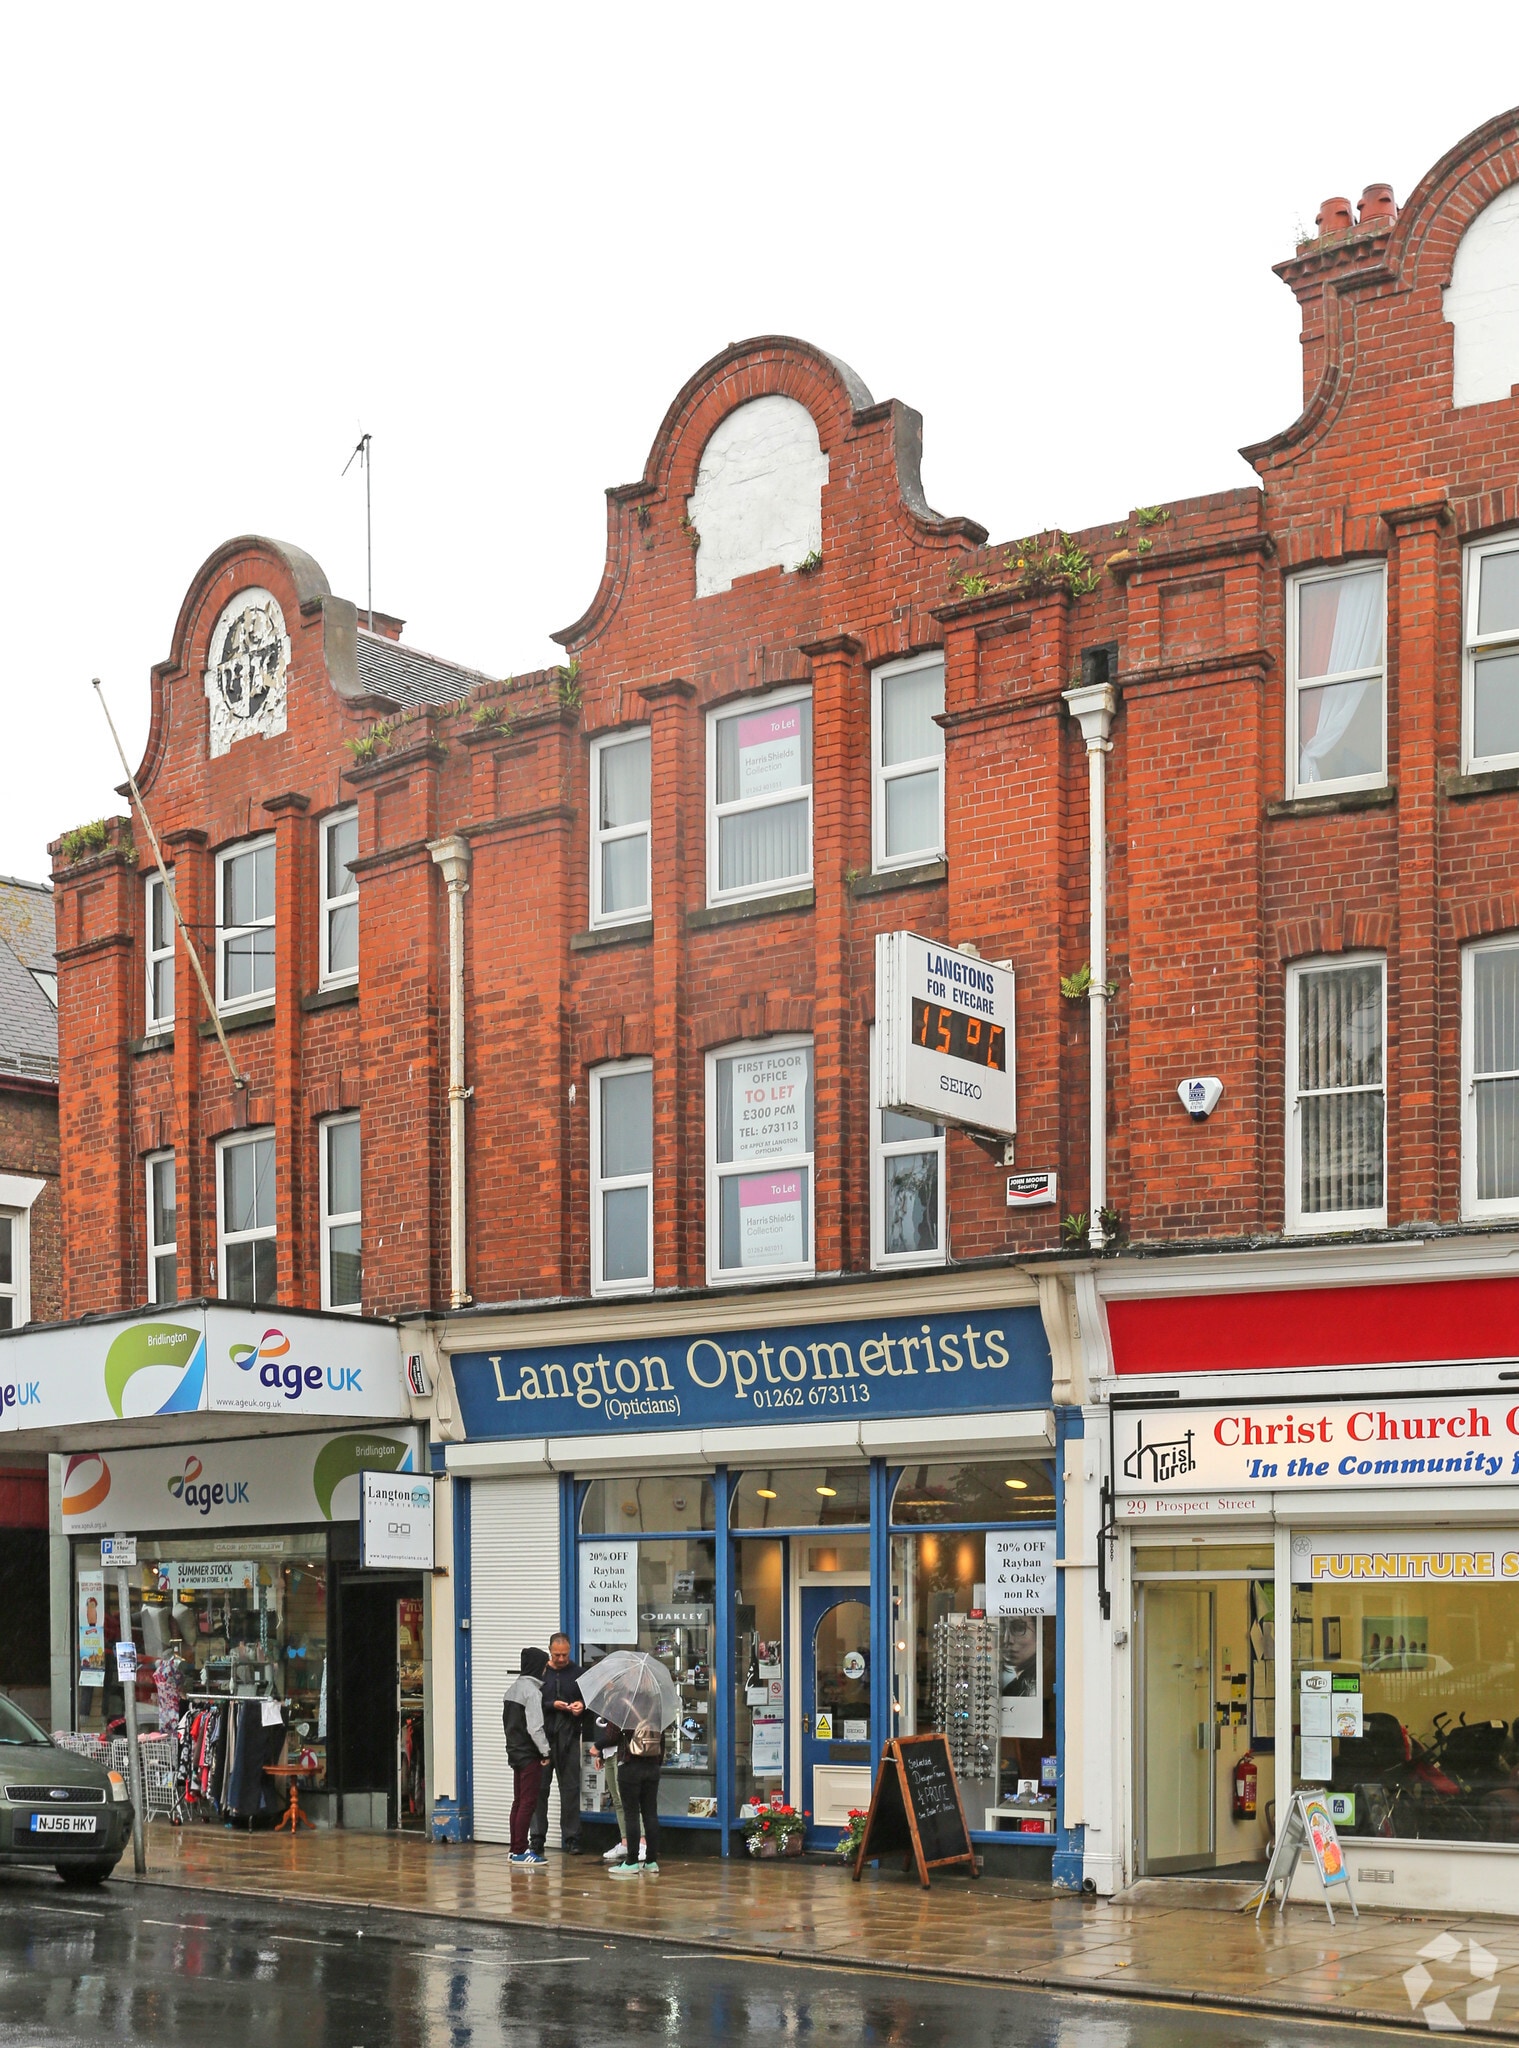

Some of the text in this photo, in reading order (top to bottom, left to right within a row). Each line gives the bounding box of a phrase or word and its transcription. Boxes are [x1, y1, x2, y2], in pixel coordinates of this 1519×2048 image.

[770, 719, 795, 732] To Let
[745, 749, 794, 767] Harris Shields
[745, 762, 782, 776] Collection
[927, 952, 994, 994] LANGTONS
[927, 979, 994, 1016] FOR EYECARE
[737, 1056, 802, 1073] FIRST FLOOR
[752, 1071, 788, 1084] OFFICE
[745, 1085, 795, 1103] TO LET
[940, 1075, 982, 1100] SEIKO
[743, 1104, 796, 1120] £300 PCM
[739, 1121, 799, 1138] TEL: 673113
[749, 1141, 764, 1149] APPLY
[772, 1138, 798, 1146] LANGTON
[755, 1147, 783, 1155] OPTICIANS
[1026, 1176, 1047, 1184] MOORE
[771, 1184, 796, 1195] To Let
[746, 1213, 795, 1226] Harris Shields
[747, 1225, 783, 1236] Collection
[147, 1333, 188, 1347] Bridlington
[488, 1324, 1010, 1409] Langton Optometrists
[216, 1399, 282, 1409] www.ageuk.org.uk
[604, 1383, 870, 1420] (Opticians) 01262 673113
[1214, 1415, 1333, 1446] Christ
[1347, 1408, 1491, 1442] Church
[355, 1445, 396, 1458] Bridlington
[1287, 1457, 1329, 1477] the
[1338, 1451, 1503, 1476] Community
[368, 1486, 410, 1502] Langton
[1127, 1498, 1256, 1514] 29 Prospect Street
[997, 1542, 1046, 1552] 20% OFF
[589, 1552, 629, 1561] 20% OFF
[178, 1564, 232, 1576] SUMMER STOCK
[1002, 1558, 1041, 1570] Rayban
[1310, 1552, 1495, 1579] FURNITURE
[593, 1566, 625, 1577] Rayban
[589, 1580, 628, 1591] & Oakley
[997, 1574, 1047, 1585] & Oakley
[612, 1594, 623, 1603] Rx
[1004, 1589, 1040, 1599] non Rx
[590, 1608, 627, 1619] Sunspecs
[999, 1605, 1045, 1616] Sunspecs
[925, 1784, 950, 1802] PRICE
[39, 1817, 94, 1831] NJ56 HKY
